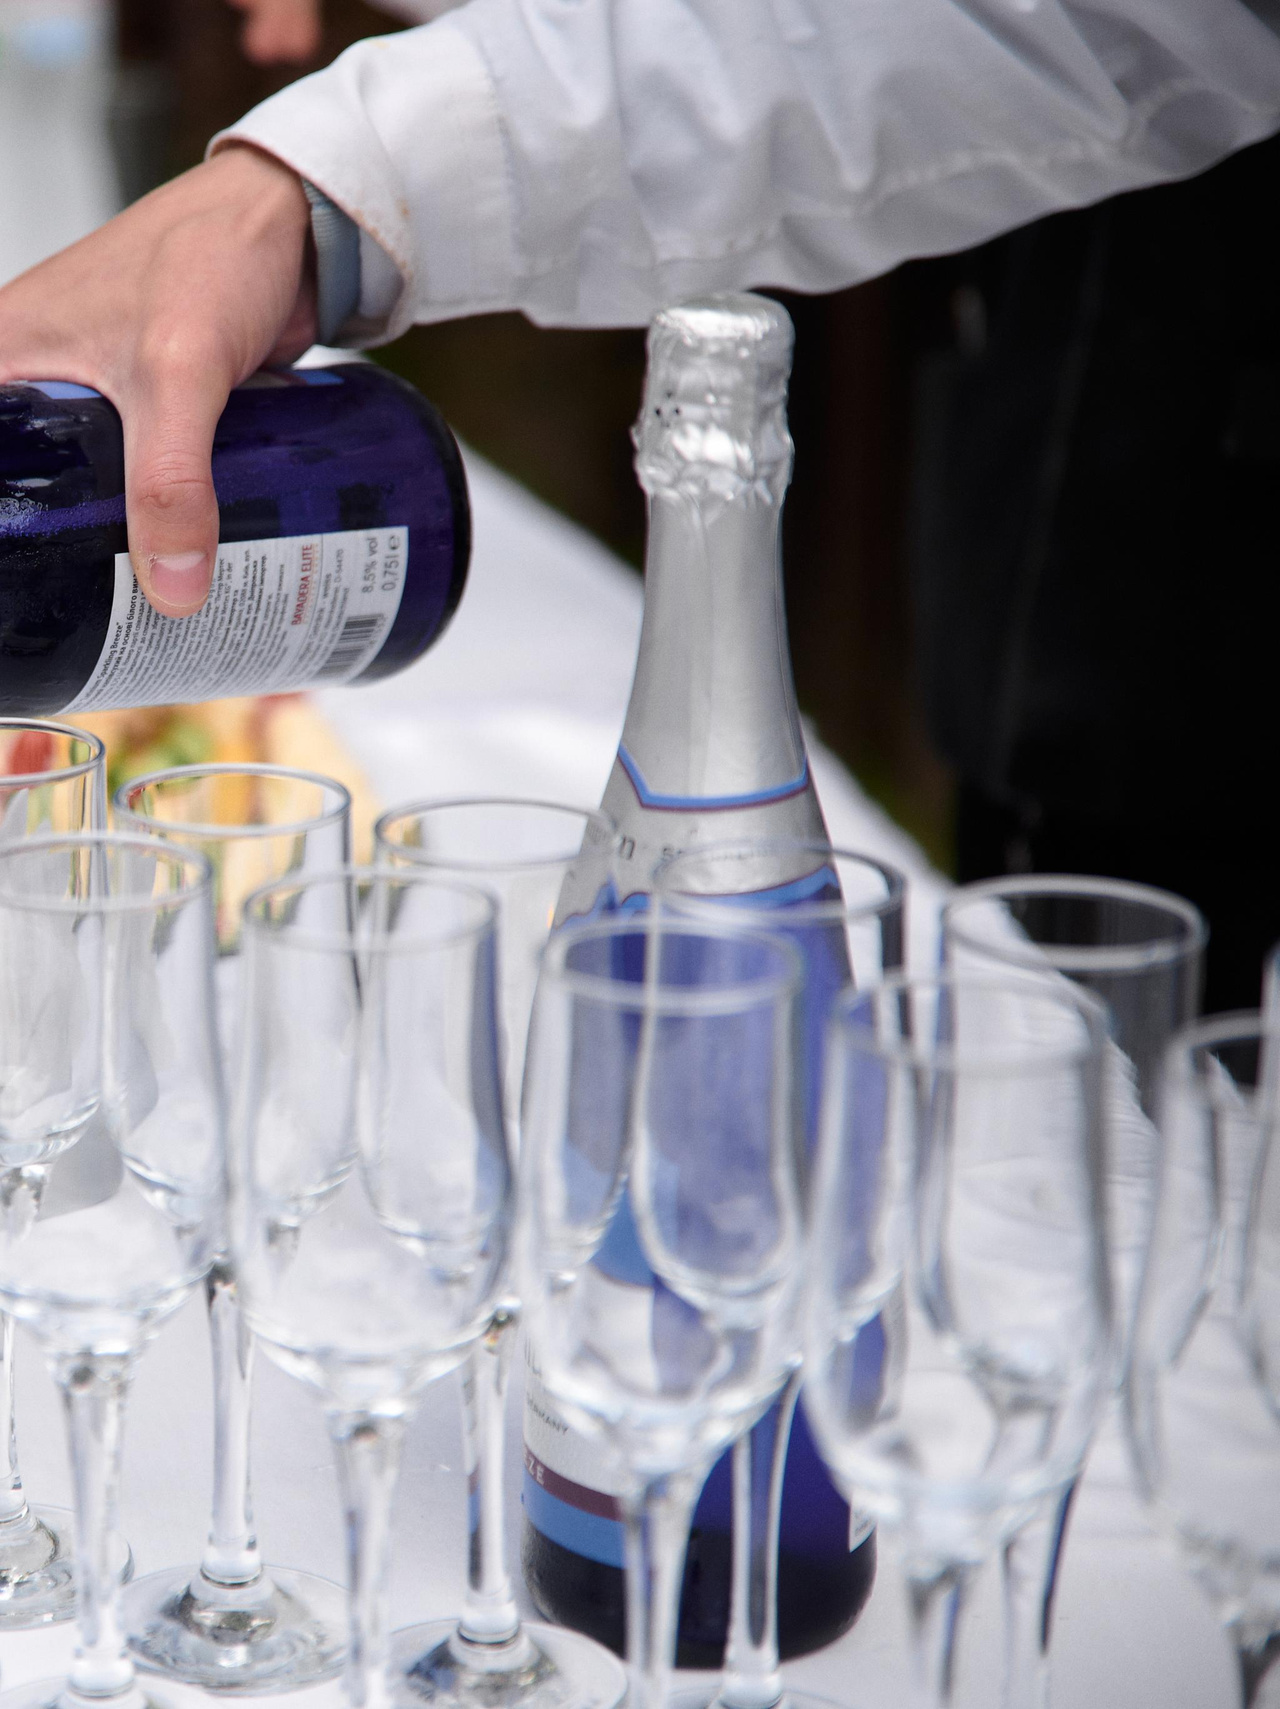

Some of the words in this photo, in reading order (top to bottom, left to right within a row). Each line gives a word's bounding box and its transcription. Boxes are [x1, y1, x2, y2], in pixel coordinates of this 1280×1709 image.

[366, 535, 377, 557] vol
[291, 575, 310, 625] BAYADERA
[302, 543, 312, 572] ELITE
[361, 561, 377, 593] 8,5%
[125, 594, 137, 620] білого
[122, 620, 132, 645] основі
